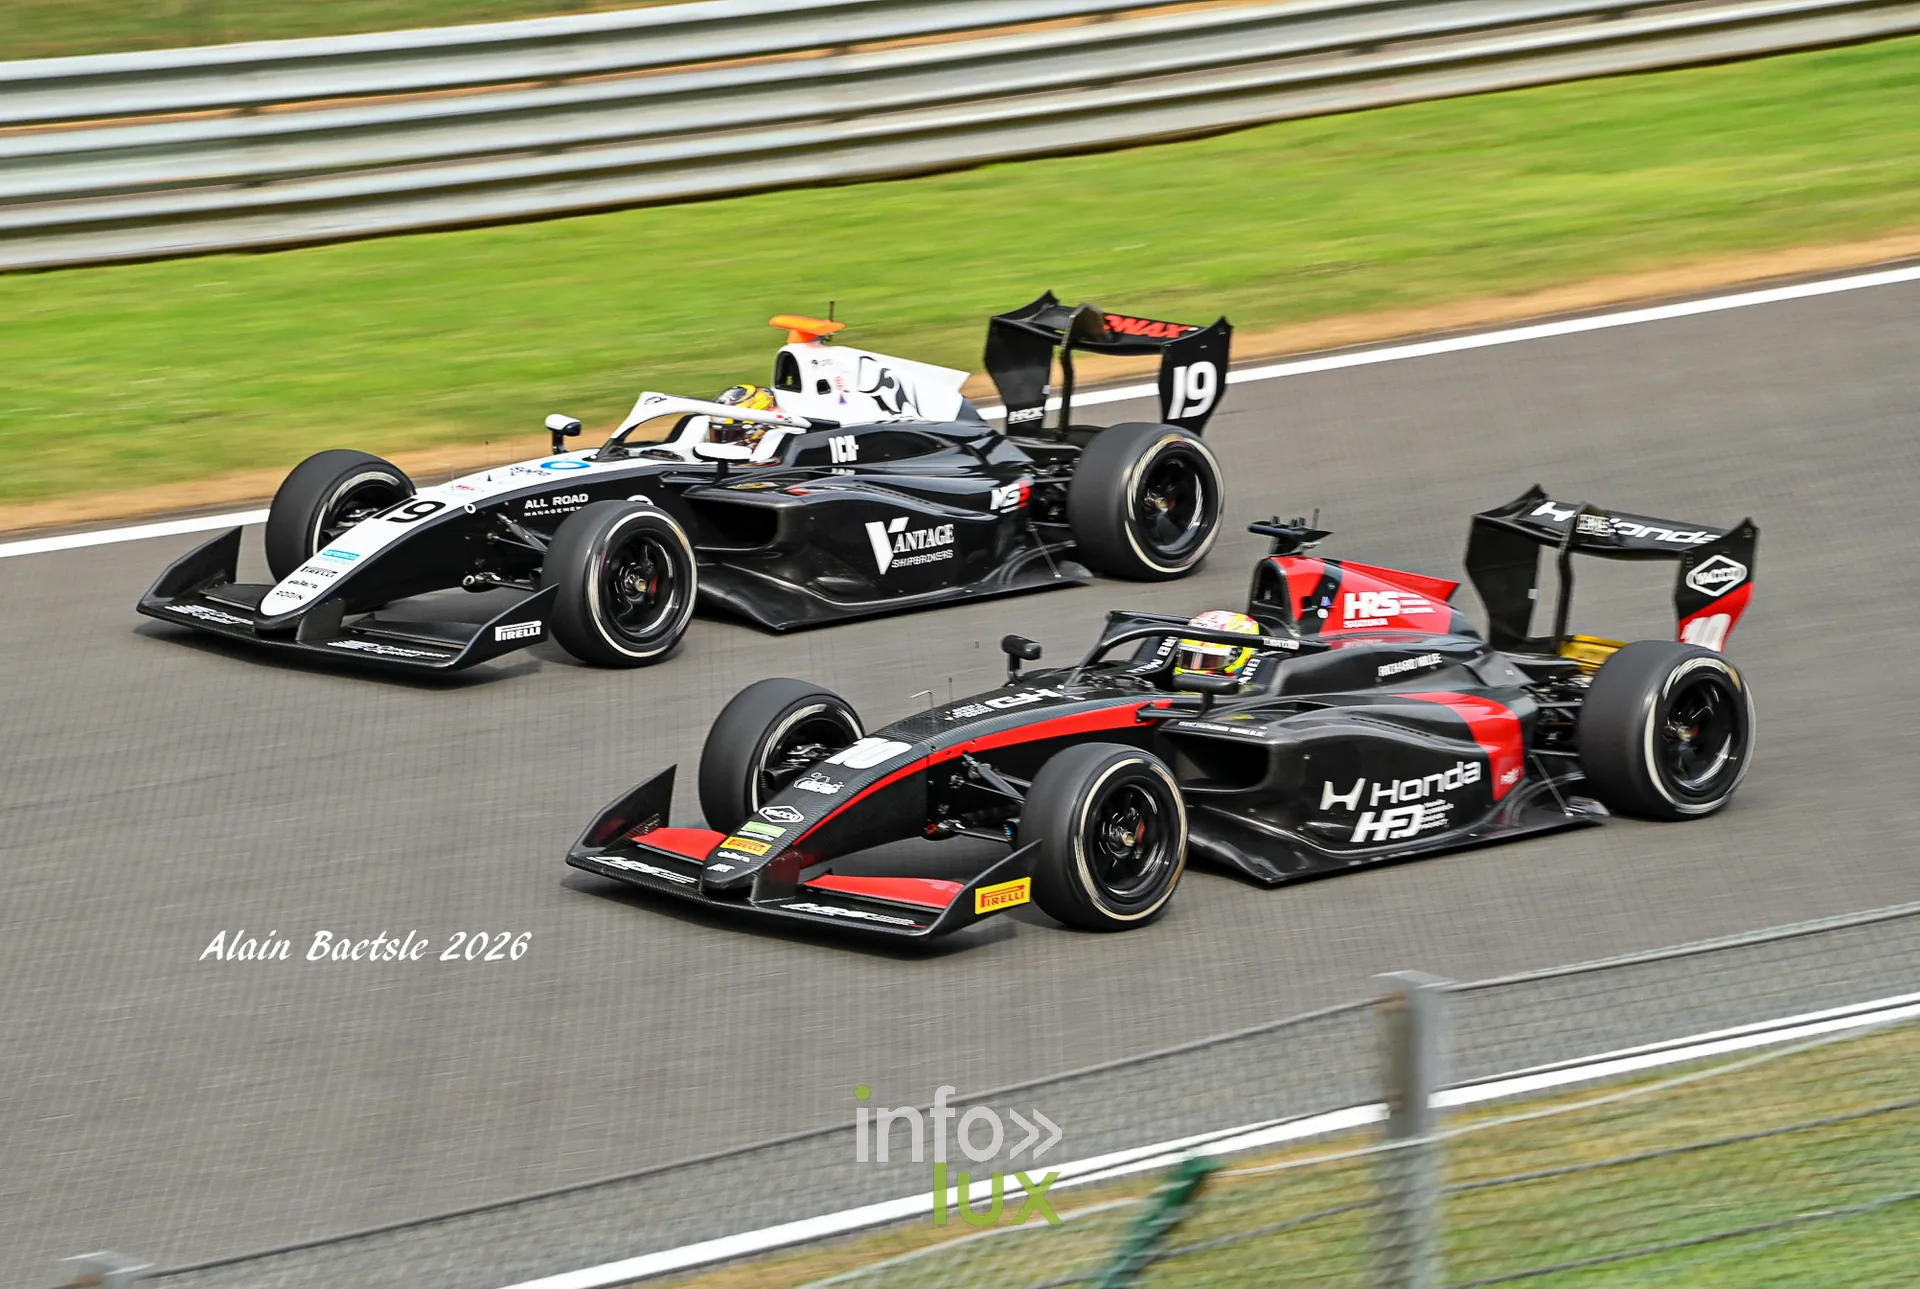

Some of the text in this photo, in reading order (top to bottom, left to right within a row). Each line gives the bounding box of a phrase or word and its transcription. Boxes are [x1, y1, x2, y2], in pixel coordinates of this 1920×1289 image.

[1167, 360, 1217, 420] 19
[523, 506, 584, 517] MANAGEMEN
[524, 493, 589, 510] ALL ROAD
[864, 516, 955, 575] VANTAGE
[1343, 591, 1402, 620] HRS
[495, 620, 542, 642] PIRELLI
[1369, 761, 1481, 807] Honda
[980, 884, 1025, 908] PIRELLI
